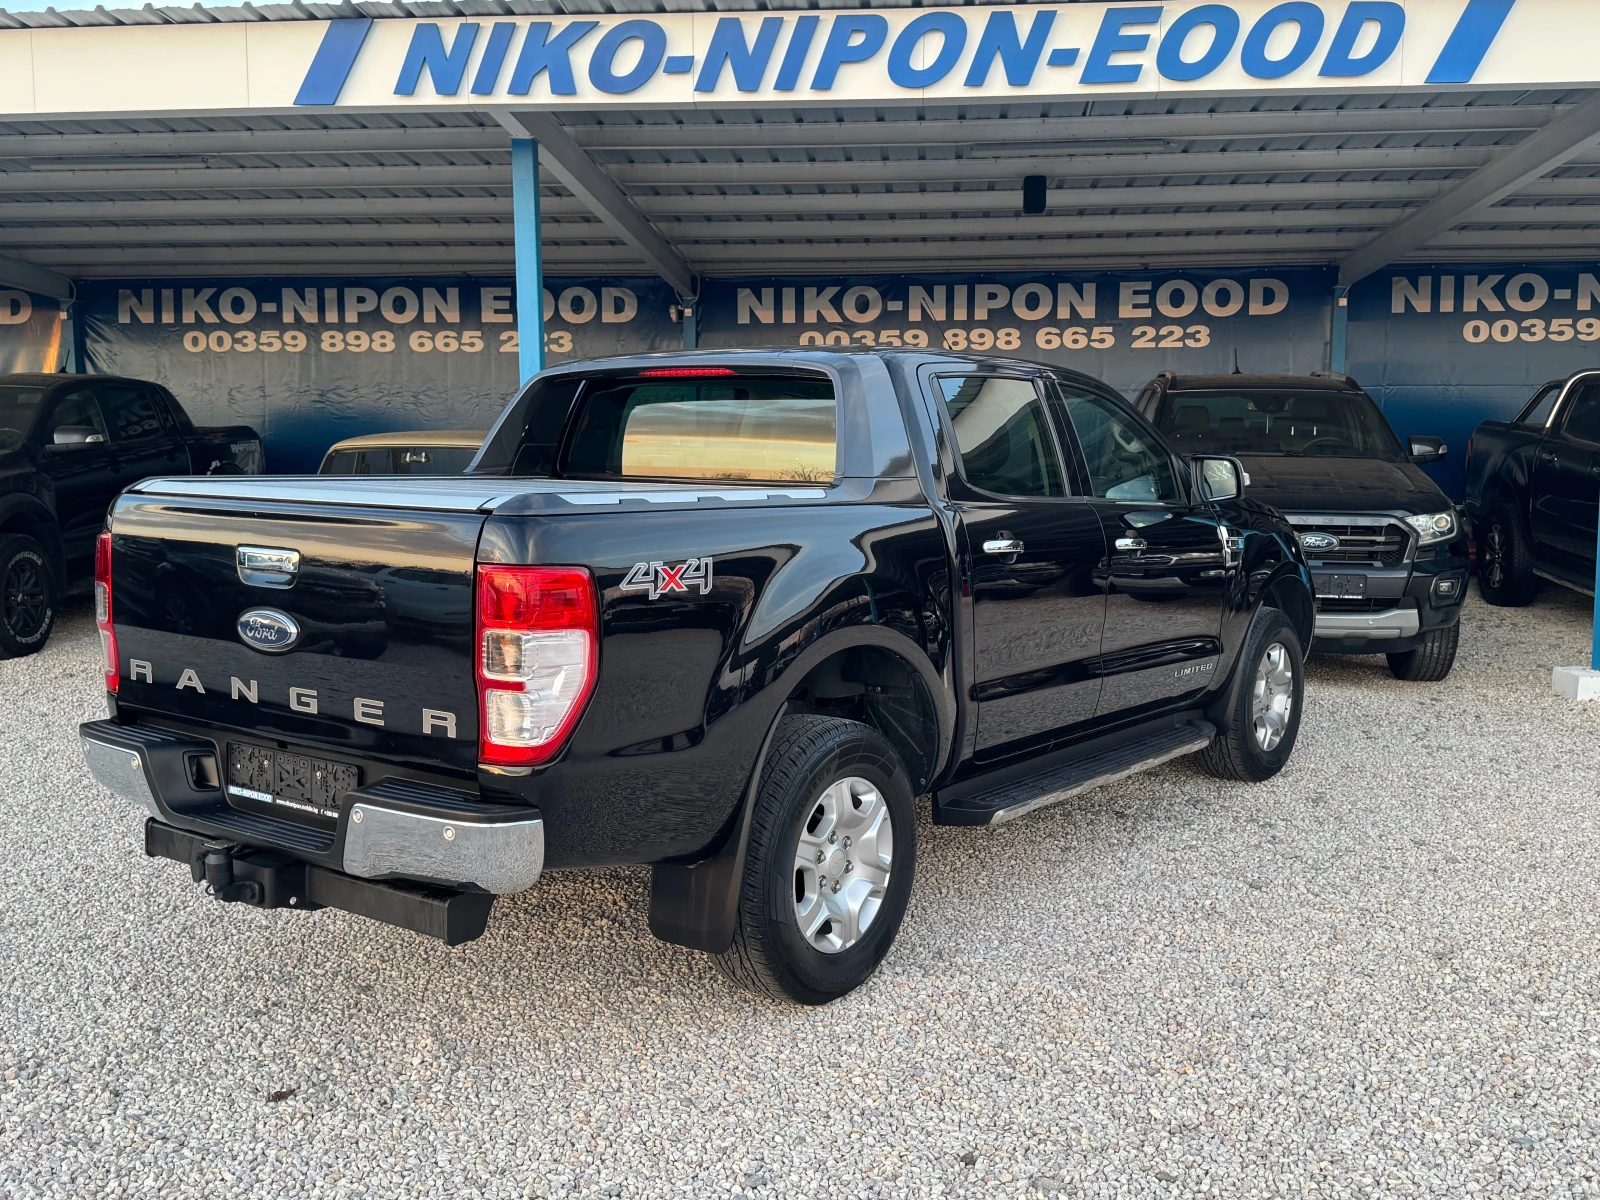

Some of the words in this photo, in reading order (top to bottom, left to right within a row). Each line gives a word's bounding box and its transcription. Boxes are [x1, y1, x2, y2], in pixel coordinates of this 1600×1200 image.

[393, 1, 1406, 96] NIKO-NIPON-EOOD
[118, 286, 461, 324] NIKO-NIPON
[737, 283, 1097, 324] NIKO-NIPON
[1118, 279, 1290, 319] EOOD
[183, 330, 307, 353] 00359
[320, 330, 396, 353] 898
[408, 330, 484, 353] 665
[498, 330, 574, 353] 23
[799, 329, 929, 348] 00359
[942, 327, 1022, 350] 898
[1035, 326, 1116, 350] 665
[1130, 325, 1211, 349] 223
[1462, 317, 1600, 343] 00359
[1297, 517, 1383, 526] NGER
[1303, 536, 1328, 547] Ford
[246, 616, 279, 641] Ford
[1174, 662, 1213, 678] LIMITED
[130, 658, 457, 738] RANGER
